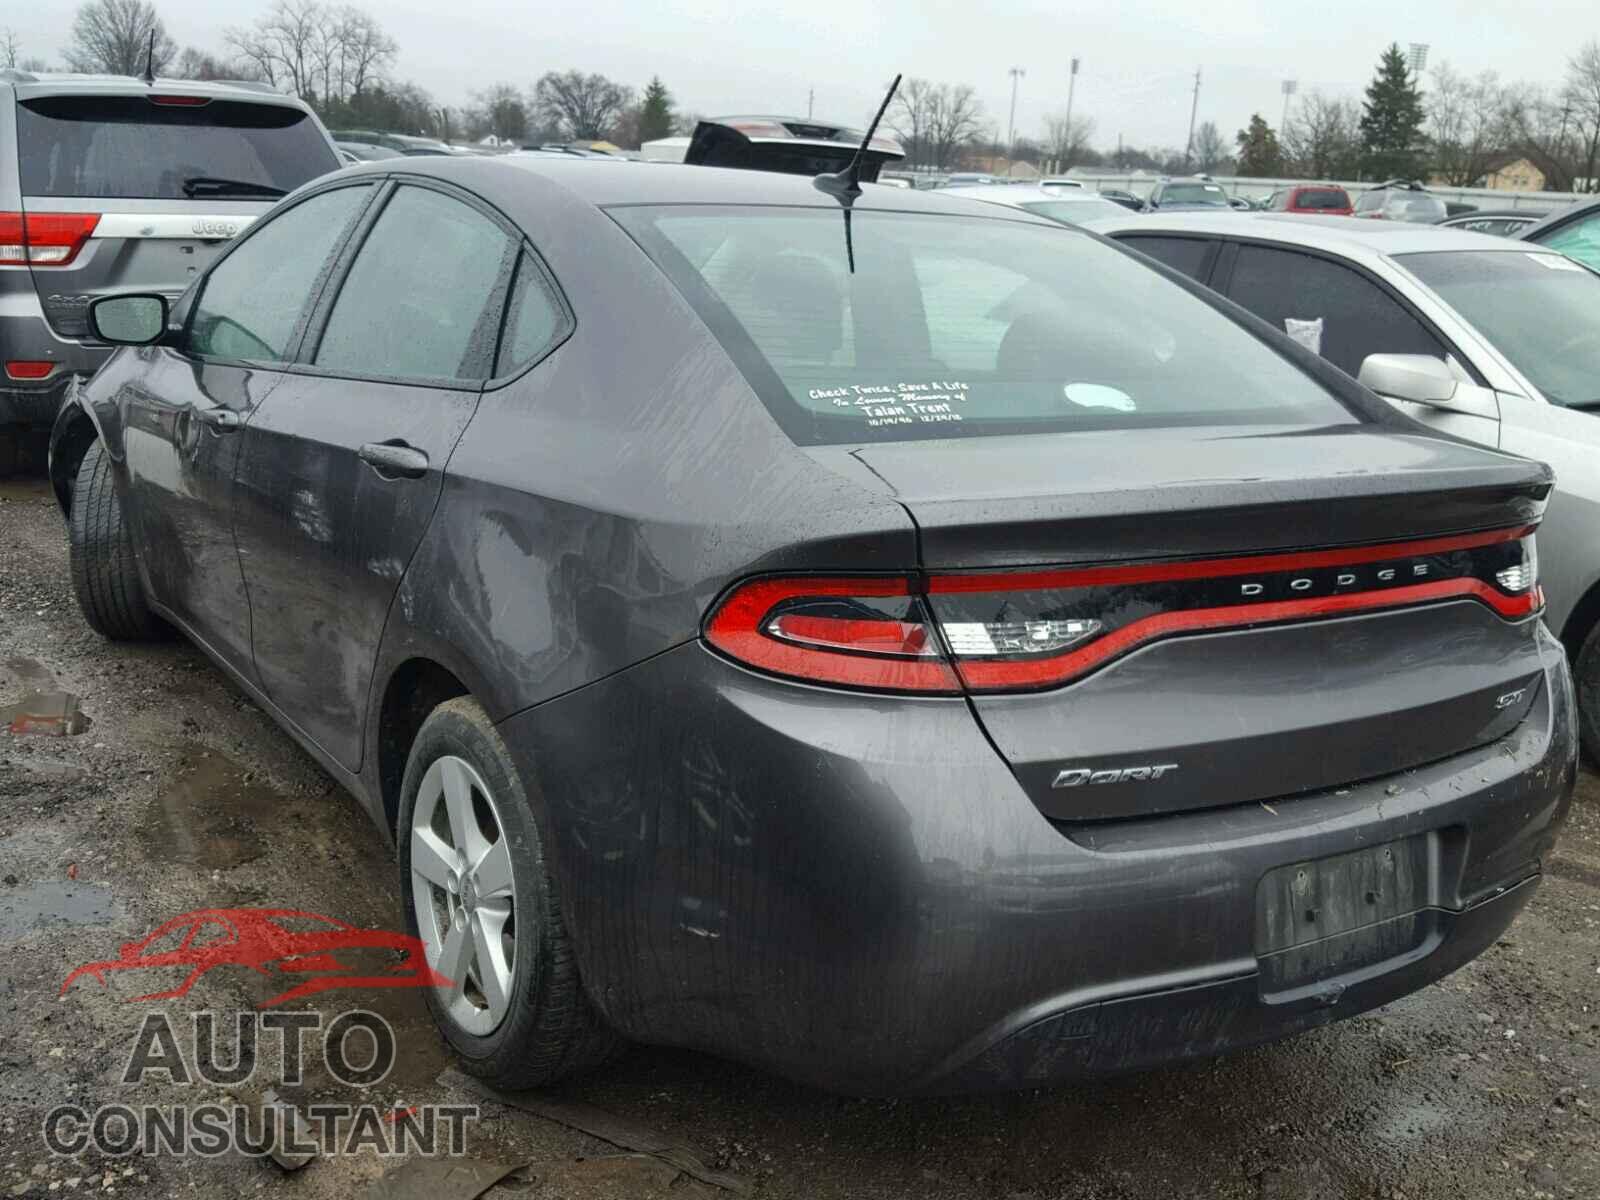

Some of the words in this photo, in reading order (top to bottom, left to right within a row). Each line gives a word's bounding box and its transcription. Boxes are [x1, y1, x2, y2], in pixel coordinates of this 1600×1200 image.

[192, 220, 237, 237] Jeep
[809, 389, 849, 399] Check
[898, 383, 928, 392] Save
[932, 382, 942, 390] A
[898, 393, 950, 401] Memory
[954, 392, 965, 401] of
[907, 402, 951, 413] Trent
[1241, 564, 1428, 595] DODGE
